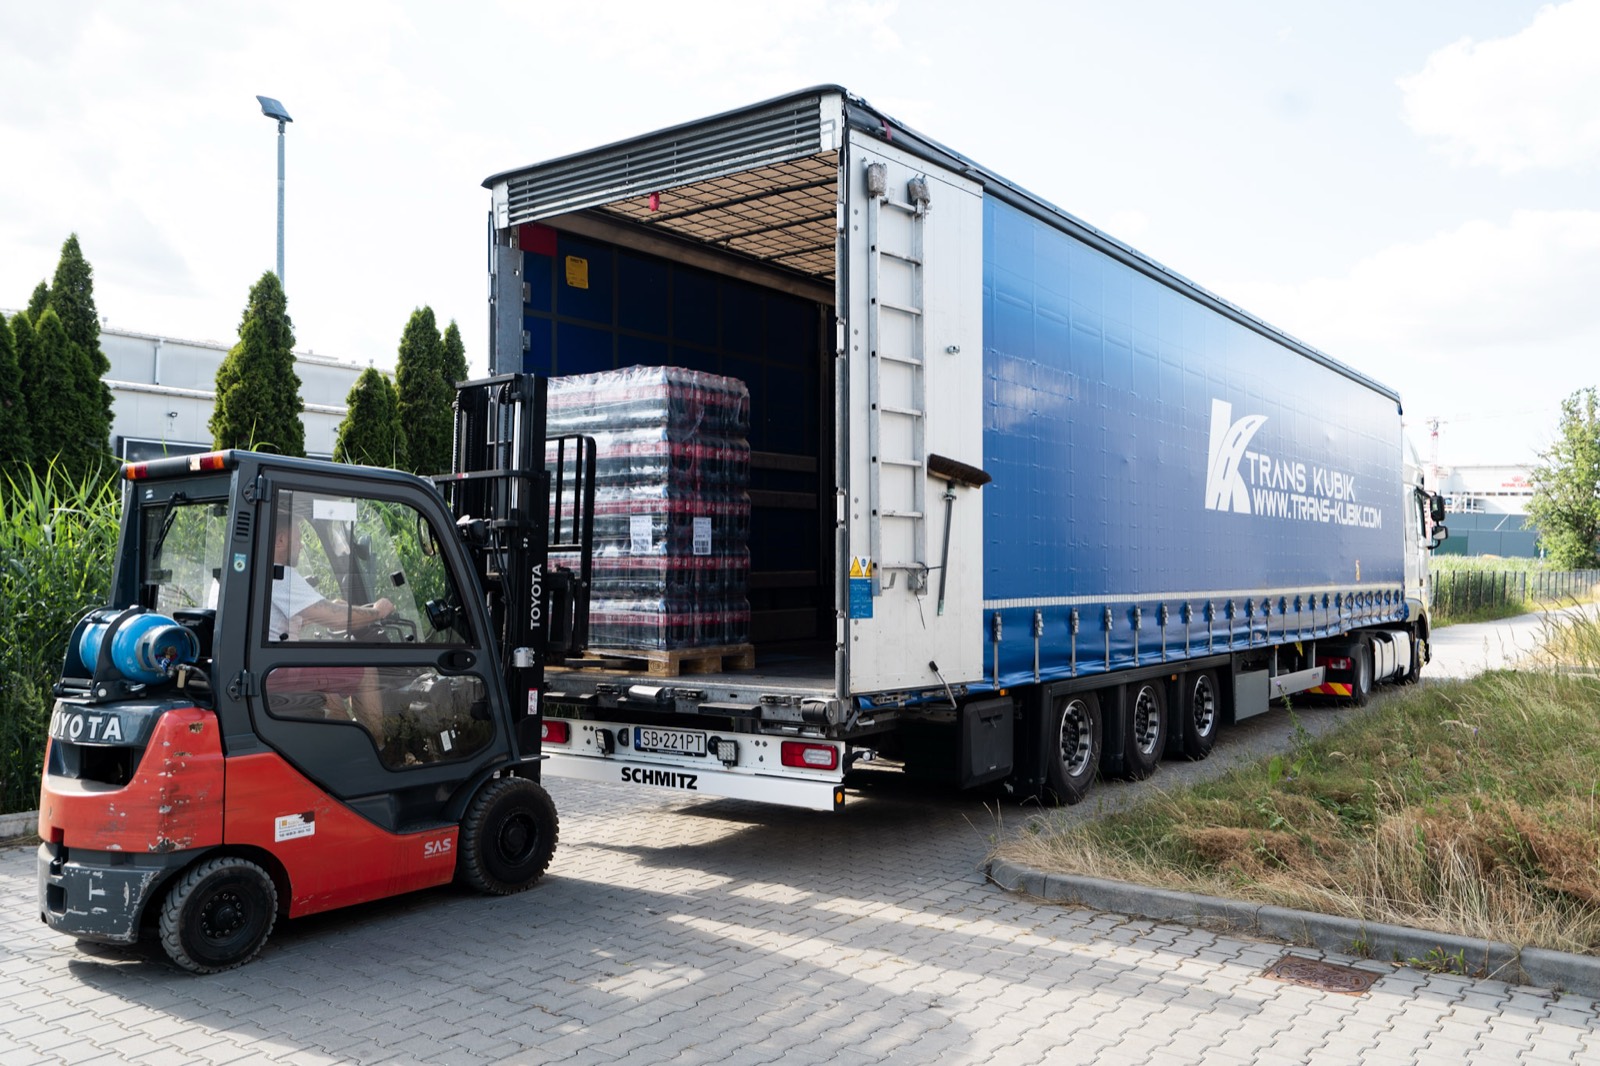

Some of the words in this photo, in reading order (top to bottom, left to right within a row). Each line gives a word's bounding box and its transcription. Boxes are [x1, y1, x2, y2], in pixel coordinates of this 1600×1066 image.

[1245, 450, 1307, 494] TRANS
[1312, 466, 1356, 503] KUBIK
[1252, 487, 1382, 529] WWW.TRANS-KUBIK.COM
[530, 563, 542, 631] TOYOTA
[51, 711, 122, 740] OYOTA
[642, 731, 659, 748] SB
[663, 732, 703, 752] 221PT
[621, 766, 698, 791] SCHMITZ
[424, 837, 452, 855] SAS
